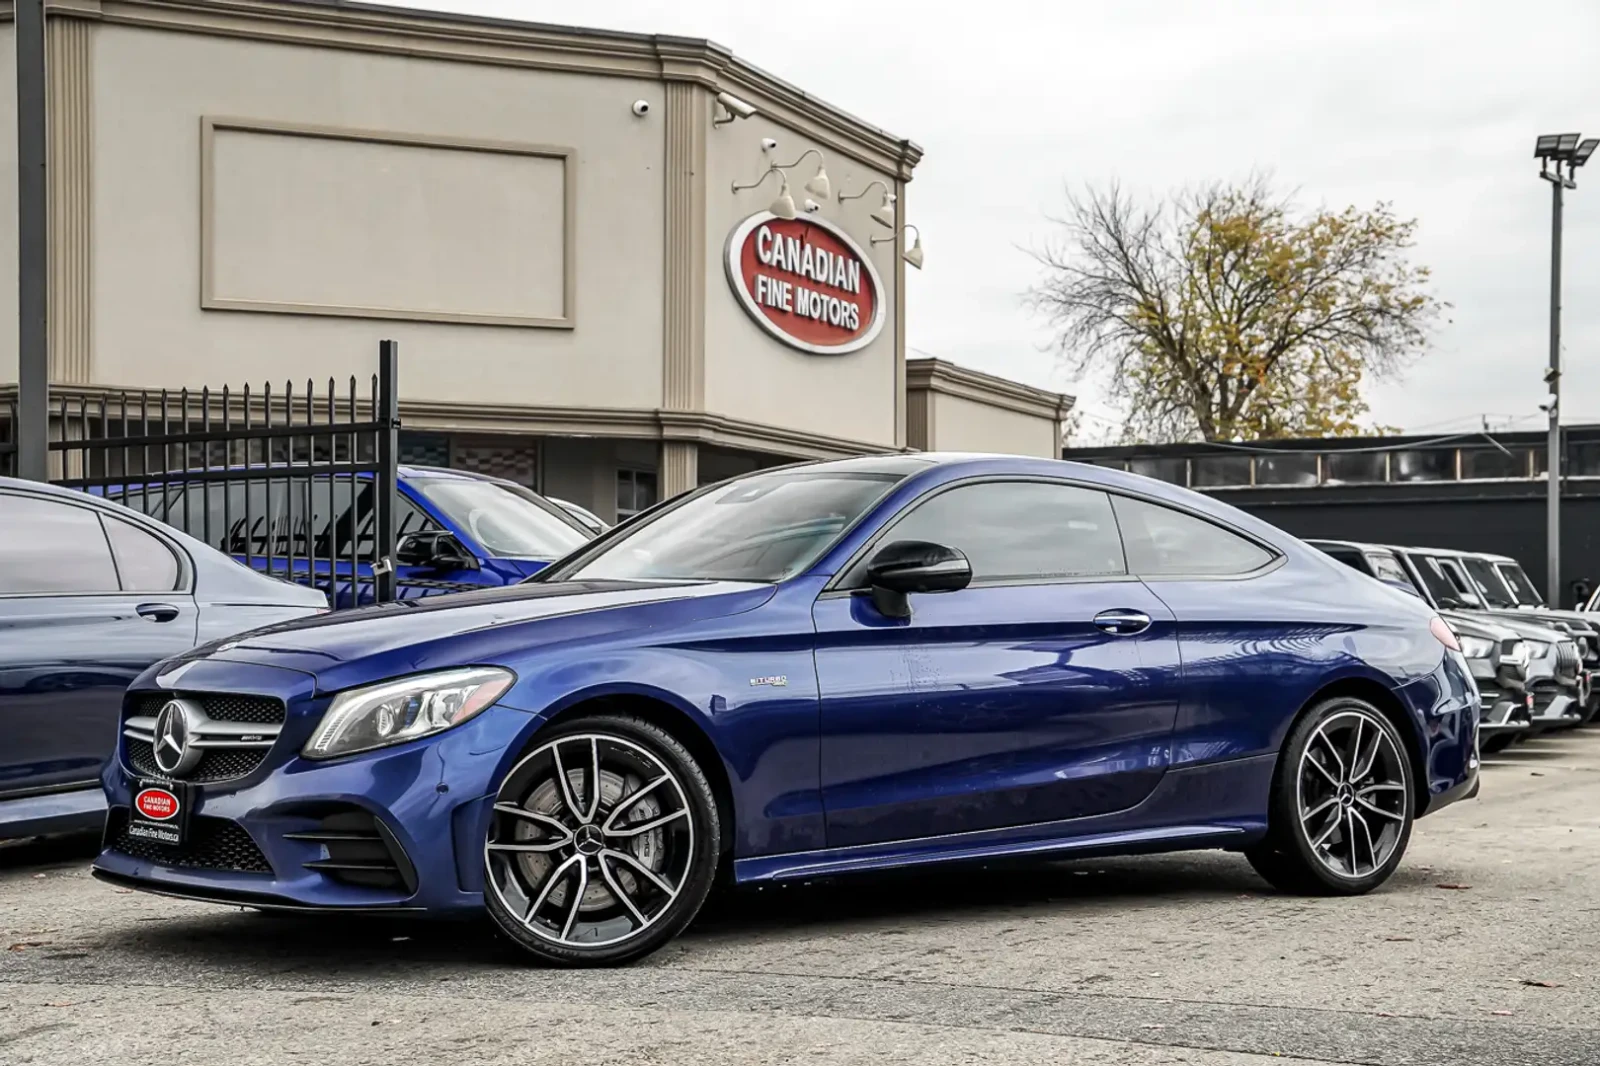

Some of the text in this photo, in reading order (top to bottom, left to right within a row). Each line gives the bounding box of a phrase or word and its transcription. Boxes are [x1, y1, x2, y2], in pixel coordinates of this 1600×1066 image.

[757, 225, 860, 294] CANADIAN
[756, 274, 860, 331] FINE MOTORS
[143, 796, 171, 806] CANADIAN
[143, 803, 170, 812] FINE MOTORS
[129, 825, 148, 837] Canadian
[148, 828, 158, 838] Fine
